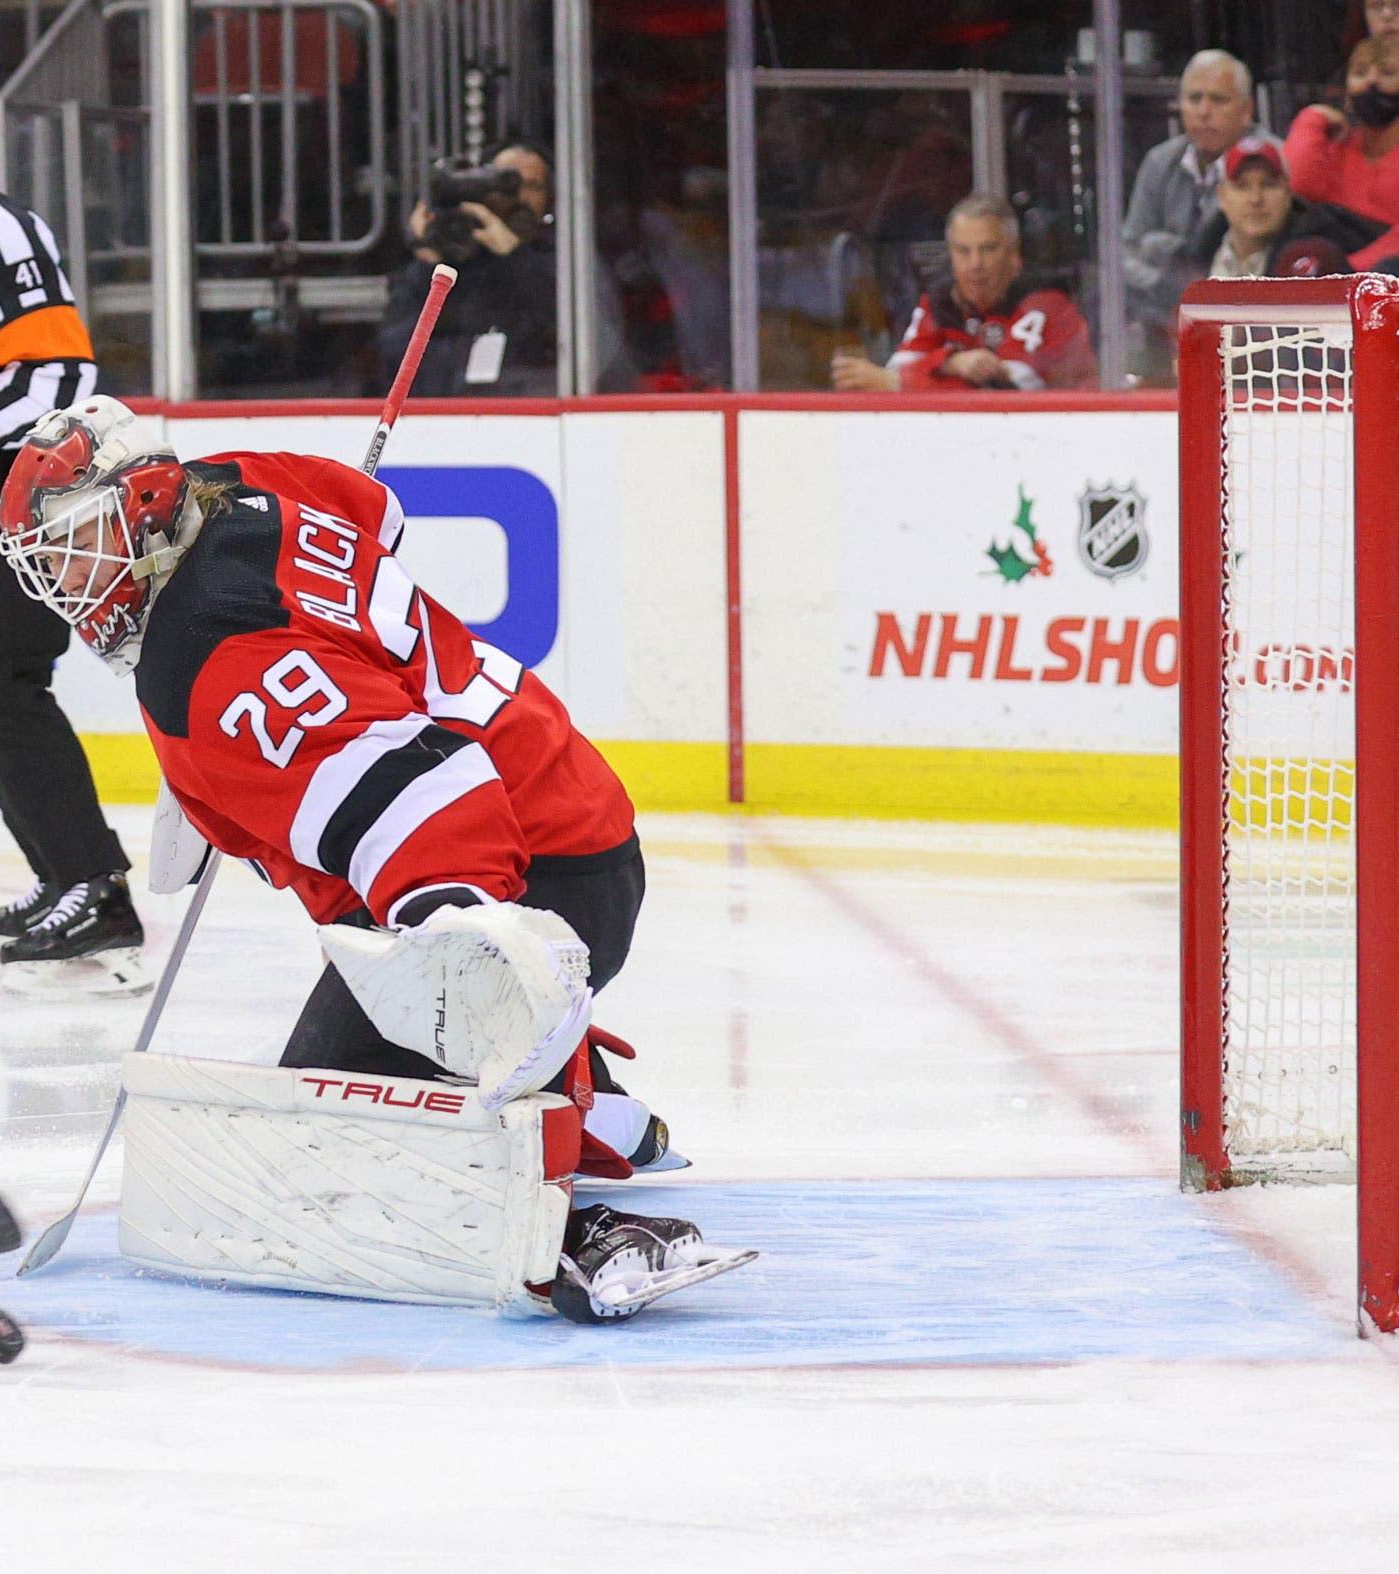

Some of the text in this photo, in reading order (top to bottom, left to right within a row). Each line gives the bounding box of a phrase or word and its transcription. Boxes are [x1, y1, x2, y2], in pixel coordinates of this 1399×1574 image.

[15, 259, 43, 288] 41
[1011, 310, 1047, 353] 4
[218, 648, 349, 769] 29
[434, 988, 446, 1065] TRUE
[303, 1077, 466, 1114] TRUE
